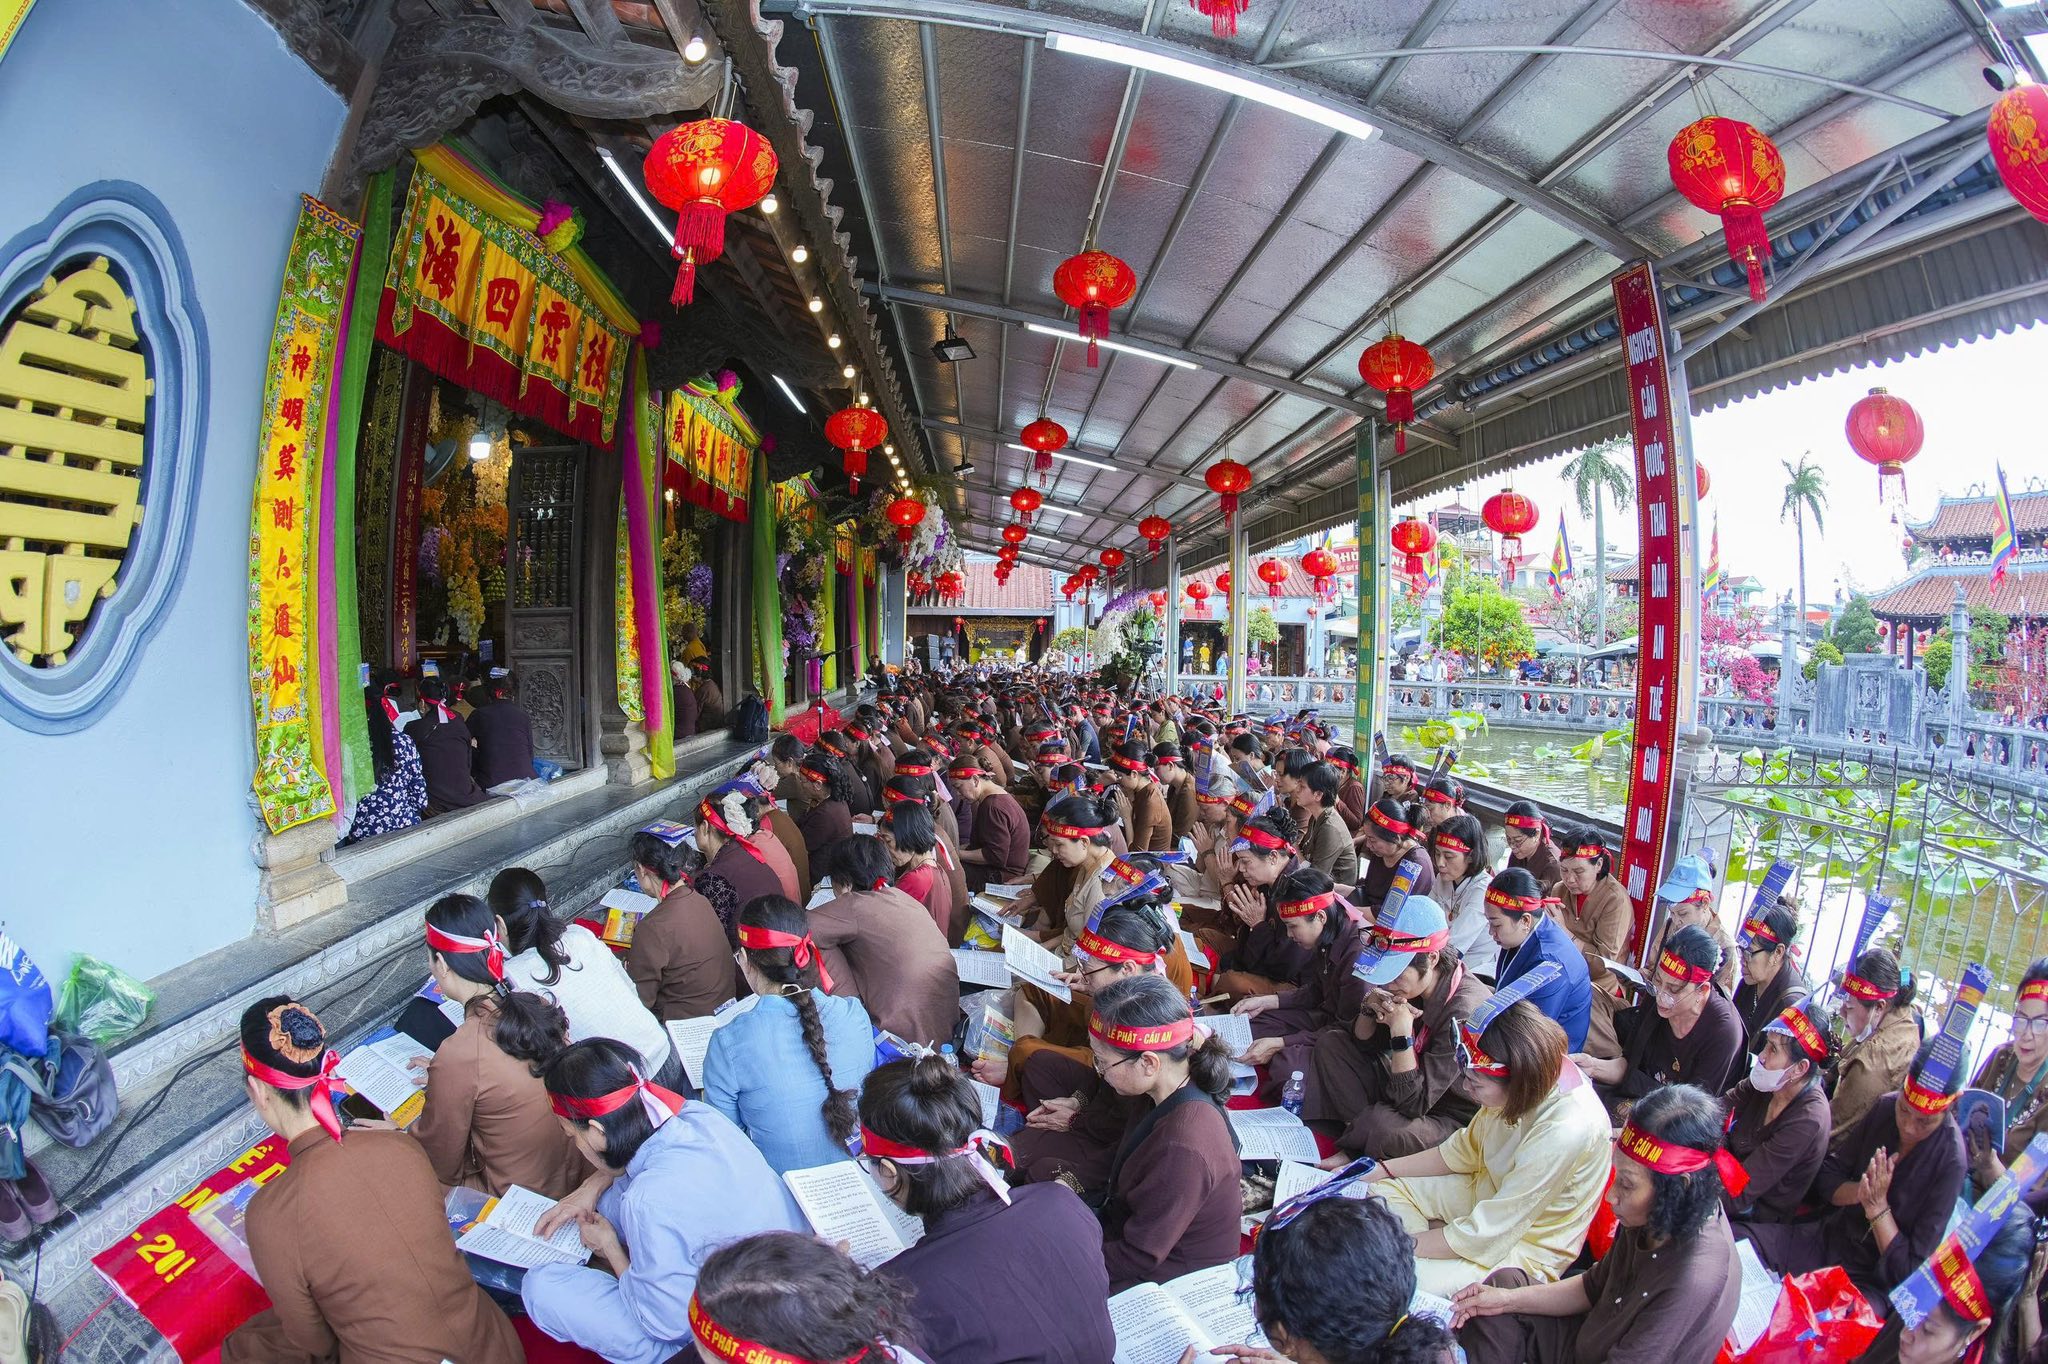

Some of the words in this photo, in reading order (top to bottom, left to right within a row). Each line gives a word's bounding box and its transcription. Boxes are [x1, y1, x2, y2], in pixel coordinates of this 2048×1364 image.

[1627, 322, 1658, 367] NGUYỆN
[1640, 375, 1658, 420] CẦU
[1644, 431, 1665, 482] QUỐC
[1649, 494, 1667, 537] THÁI
[1651, 556, 1667, 599] DÂN
[1652, 624, 1665, 660] AN
[1649, 675, 1664, 722] THẾ
[1642, 741, 1660, 784] GIỚI
[1627, 858, 1648, 902] BÌNH
[1117, 1030, 1137, 1045] PHẬT
[1144, 1030, 1160, 1045] CẦU
[1161, 1031, 1173, 1043] AN
[1634, 1136, 1653, 1158] CẦU
[1647, 1145, 1664, 1163] AN
[701, 1319, 713, 1340] LỄ
[712, 1330, 740, 1358] PHẬT
